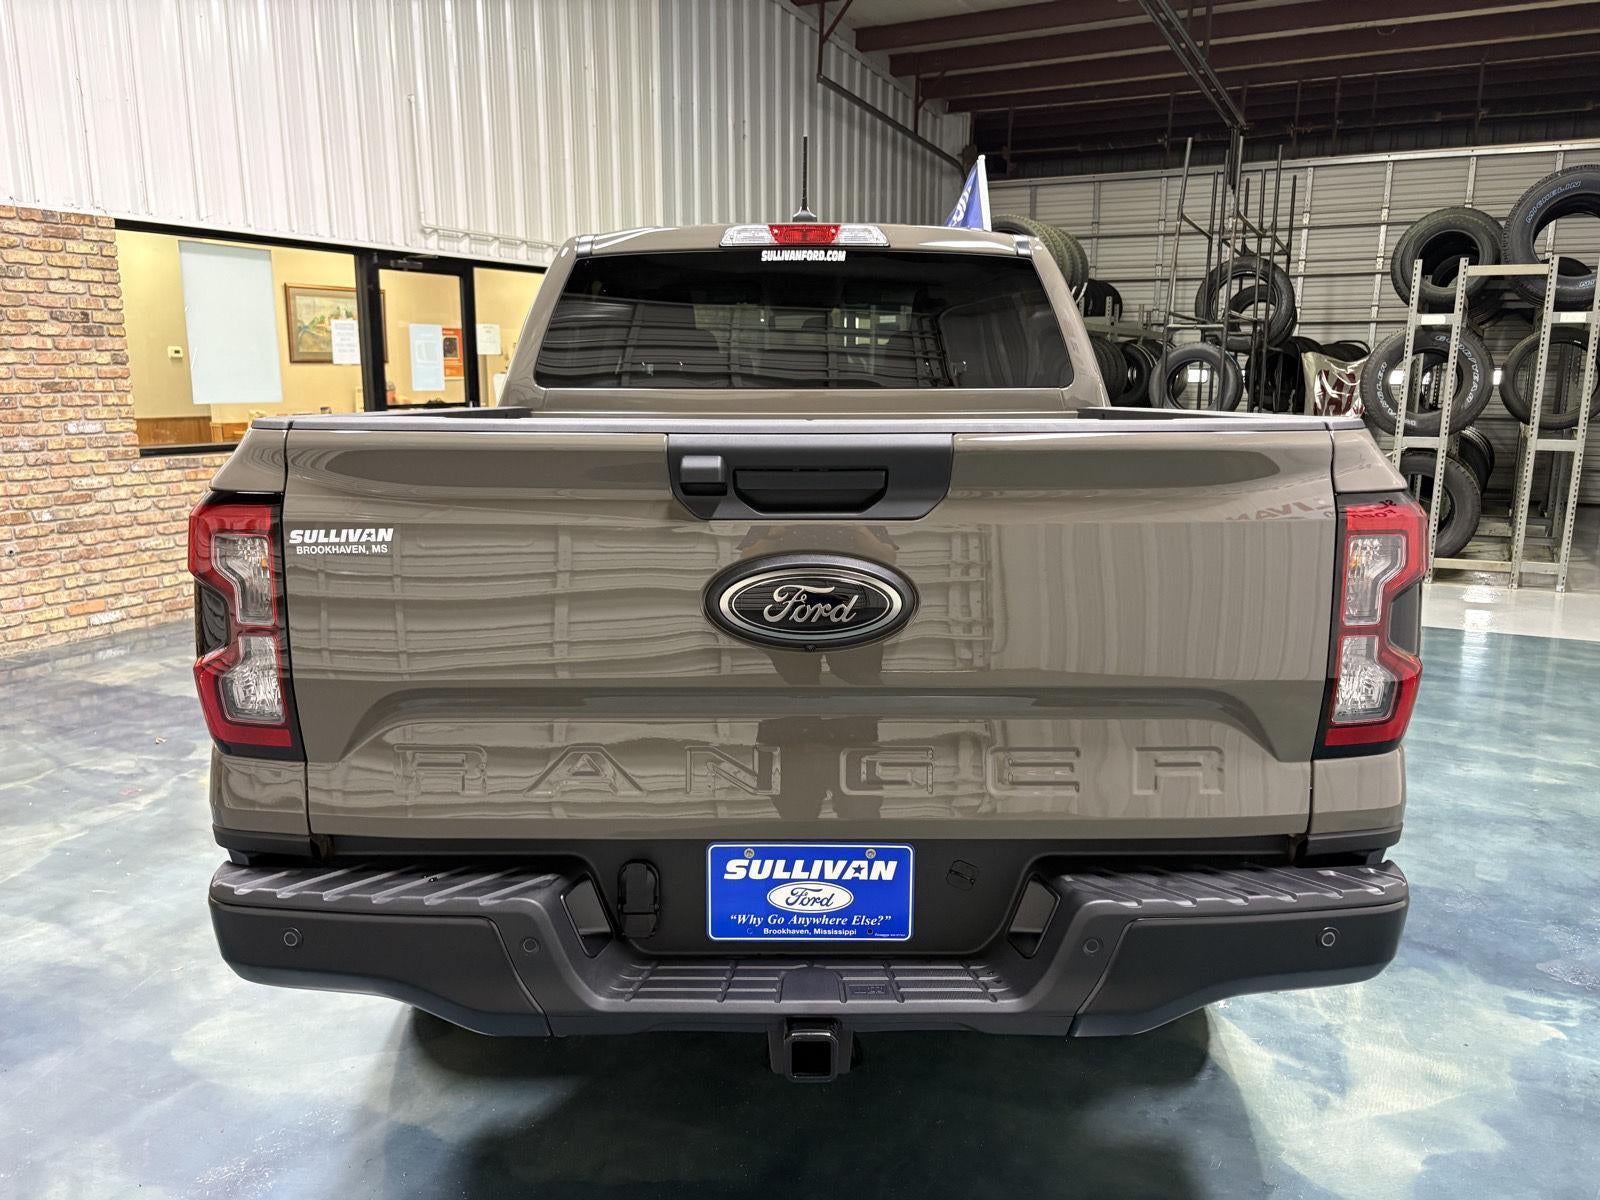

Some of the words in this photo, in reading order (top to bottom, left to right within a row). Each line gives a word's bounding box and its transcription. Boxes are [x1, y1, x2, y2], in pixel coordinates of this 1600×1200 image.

[761, 249, 847, 262] SULLIVANFORD.COM
[1376, 361, 1417, 427] WANGLER
[288, 527, 395, 544] SULLIVAN
[296, 545, 369, 555] BROOKHAVEN,
[371, 544, 388, 554] MS
[763, 584, 860, 623] Ford
[394, 743, 1226, 797] RANGER
[723, 858, 898, 881] SULLIVAN
[784, 886, 836, 908] Ford
[767, 914, 785, 925] Go
[788, 914, 848, 927] Anywhere
[763, 927, 812, 936] Brookhaven,
[813, 928, 857, 936] Mississippi
